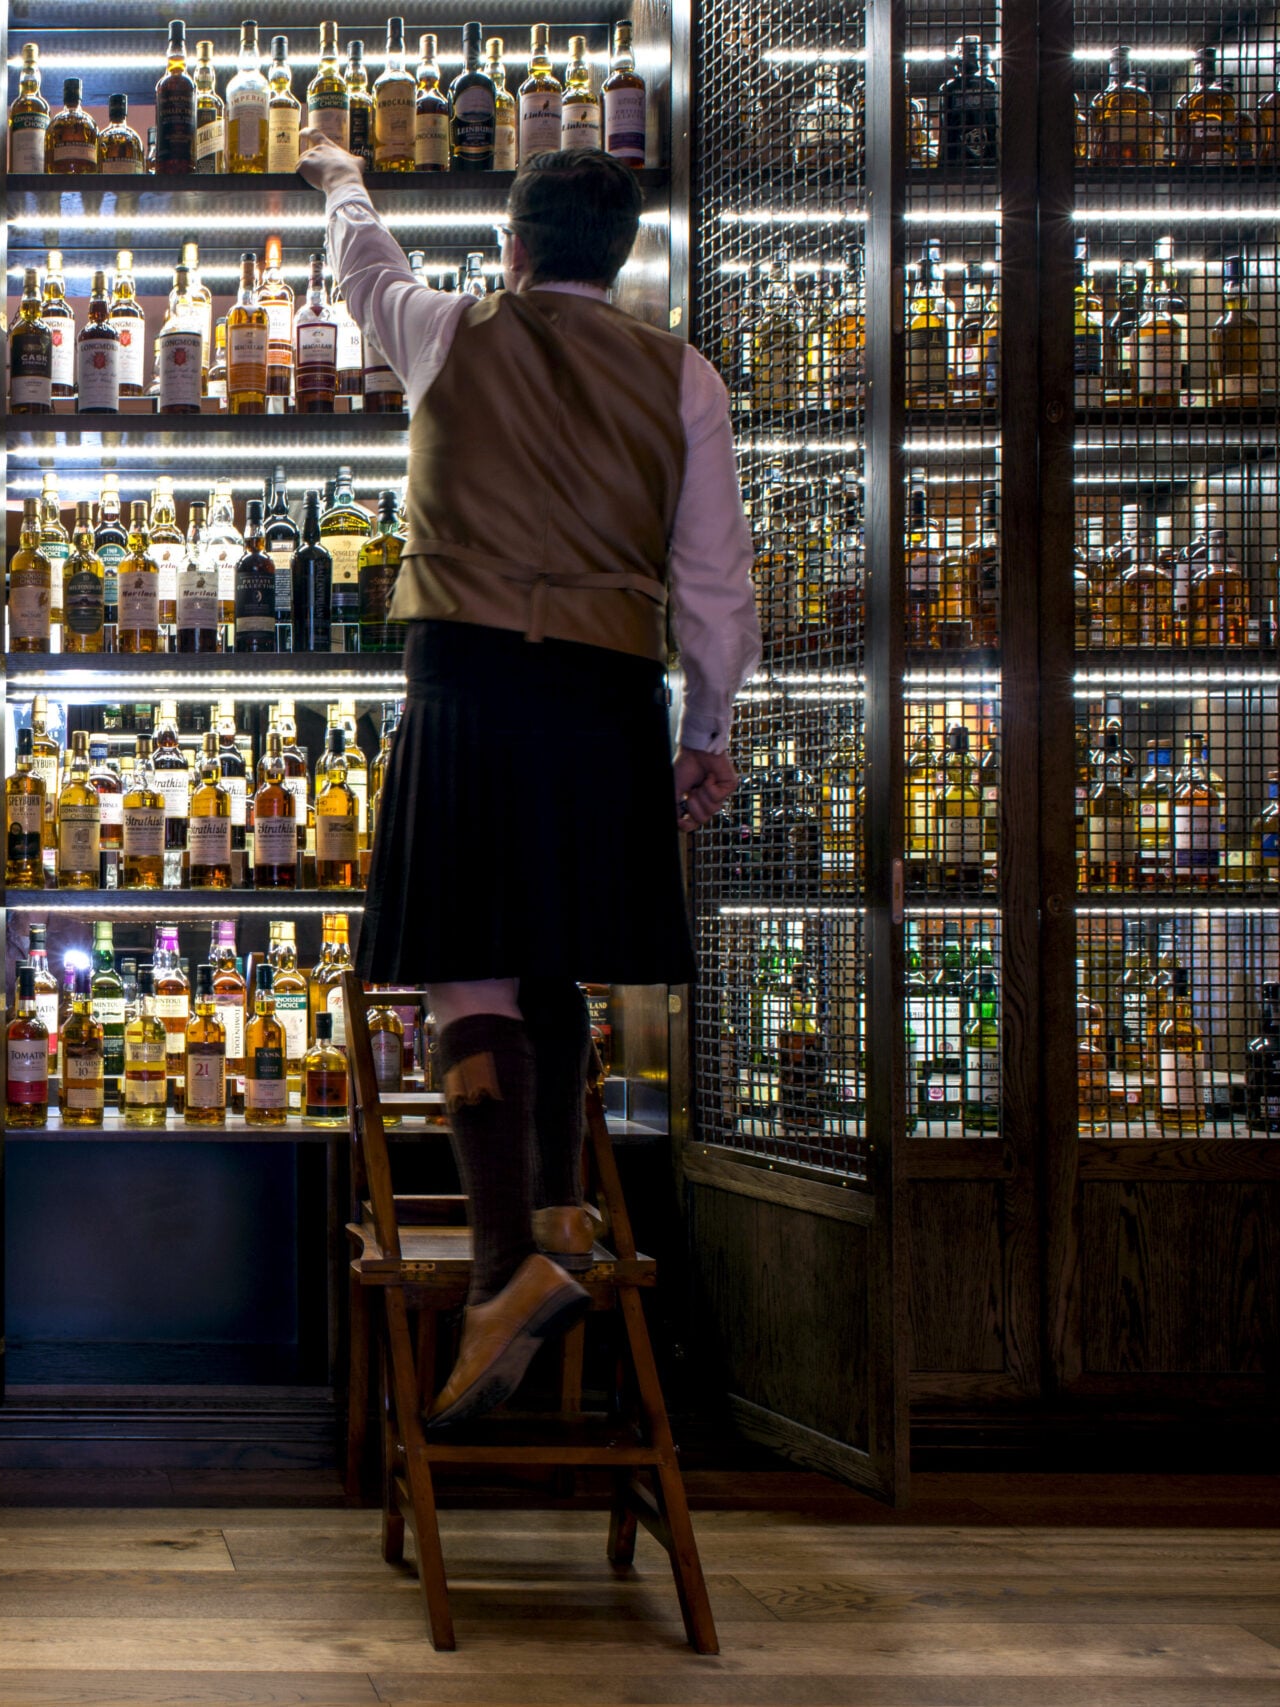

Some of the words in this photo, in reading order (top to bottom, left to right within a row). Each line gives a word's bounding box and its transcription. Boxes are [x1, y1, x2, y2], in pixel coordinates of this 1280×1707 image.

[350, 336, 360, 346] 18
[20, 354, 49, 362] CASK
[11, 1050, 46, 1060] TOMATIN
[195, 1063, 209, 1076] 21
